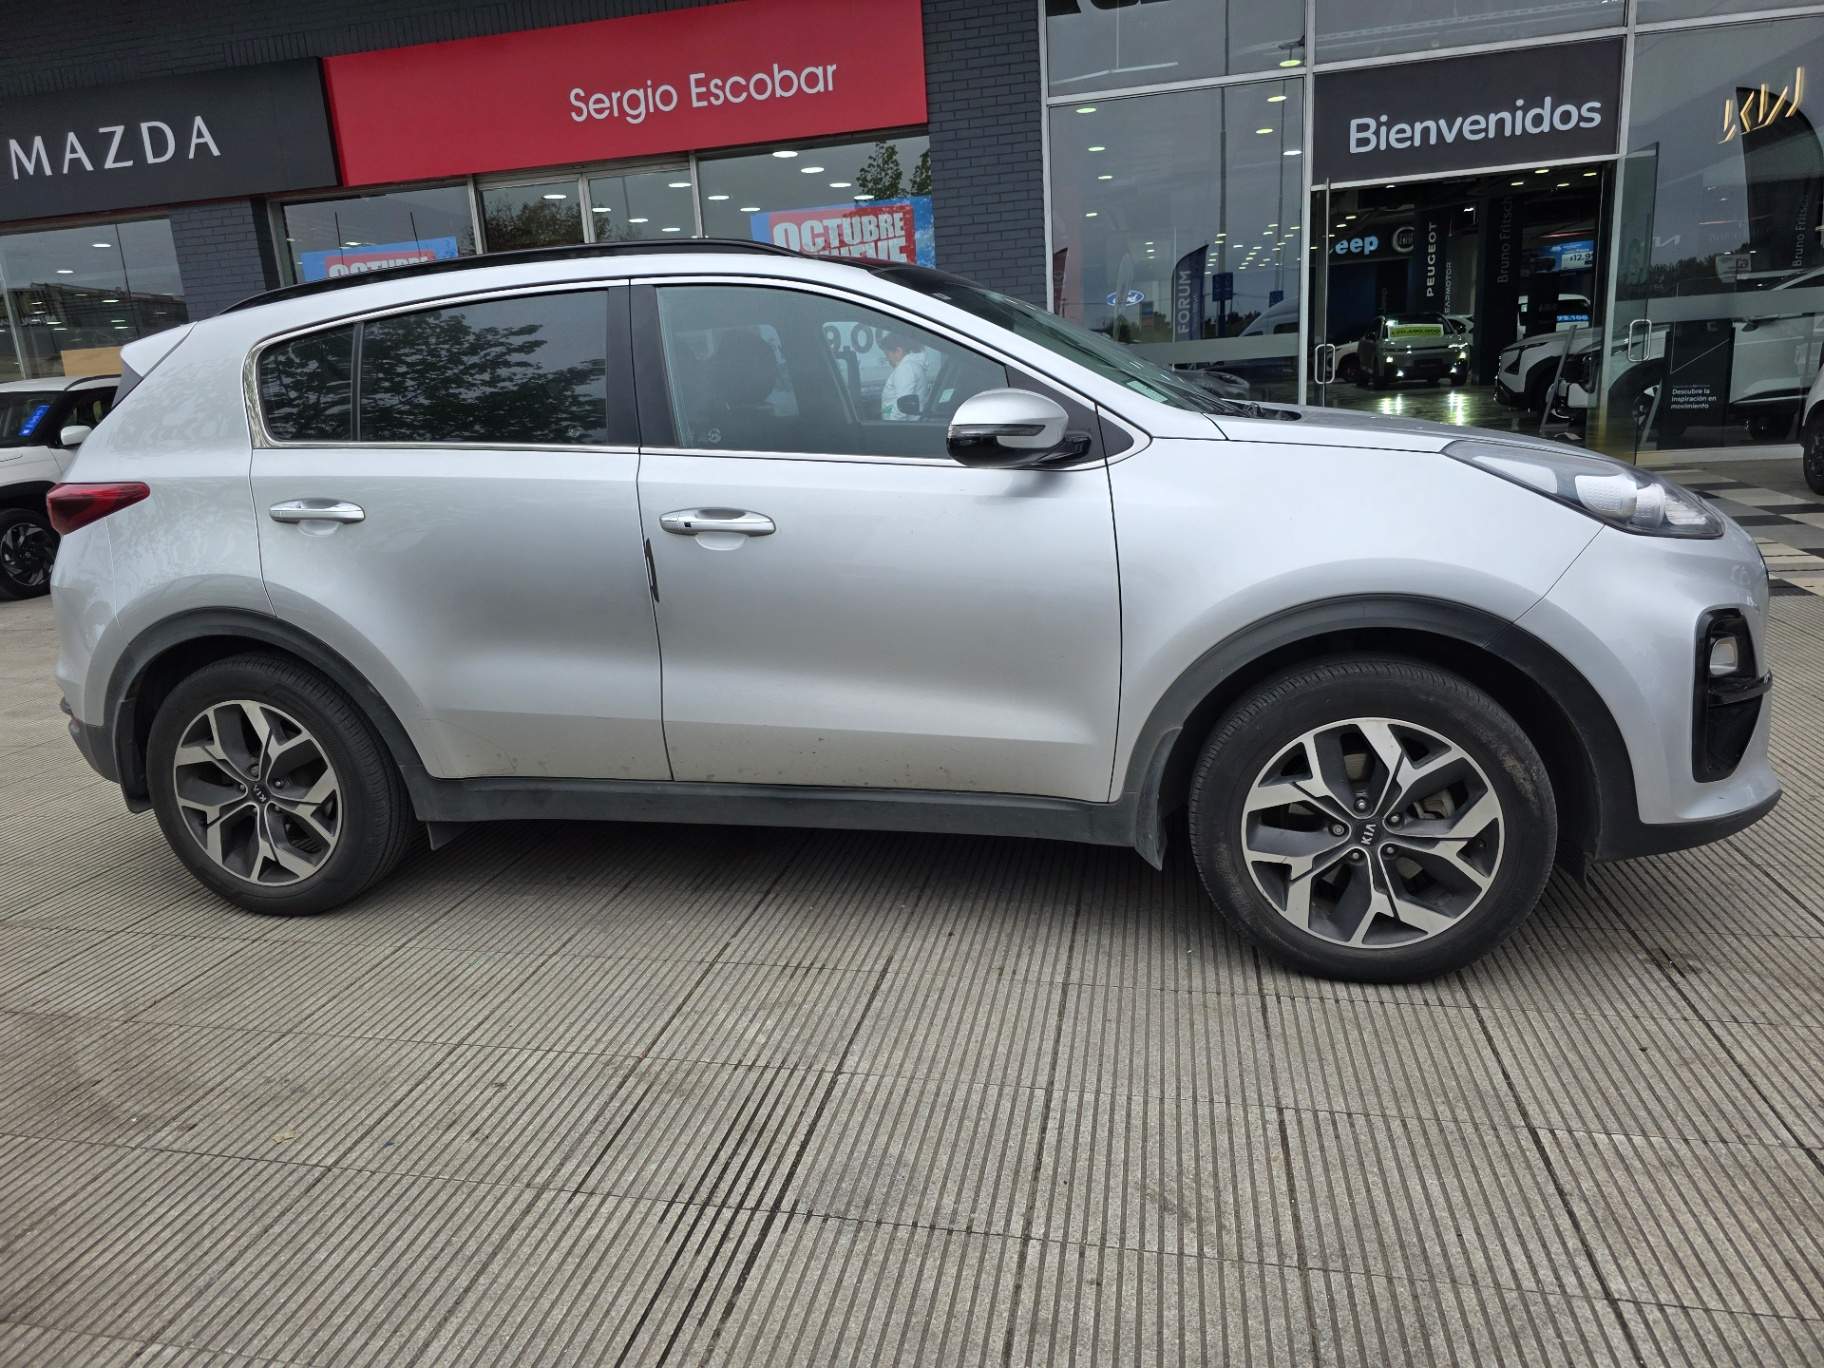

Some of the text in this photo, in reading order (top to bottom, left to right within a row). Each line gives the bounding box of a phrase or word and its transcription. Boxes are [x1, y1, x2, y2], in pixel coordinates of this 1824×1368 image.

[569, 63, 838, 125] Sergio Escobar
[8, 115, 221, 181] MAZDA
[1349, 96, 1602, 154] Bienvenidos
[772, 212, 906, 253] OCTUBRE
[1329, 235, 1379, 256] eep
[1426, 222, 1438, 297] PEUGEOT
[1497, 195, 1512, 284] Bruno Fritsch
[1792, 233, 1804, 267] Bruno
[1177, 270, 1191, 333] FORUM
[253, 784, 267, 803] KIA
[1360, 823, 1377, 846] KIA
